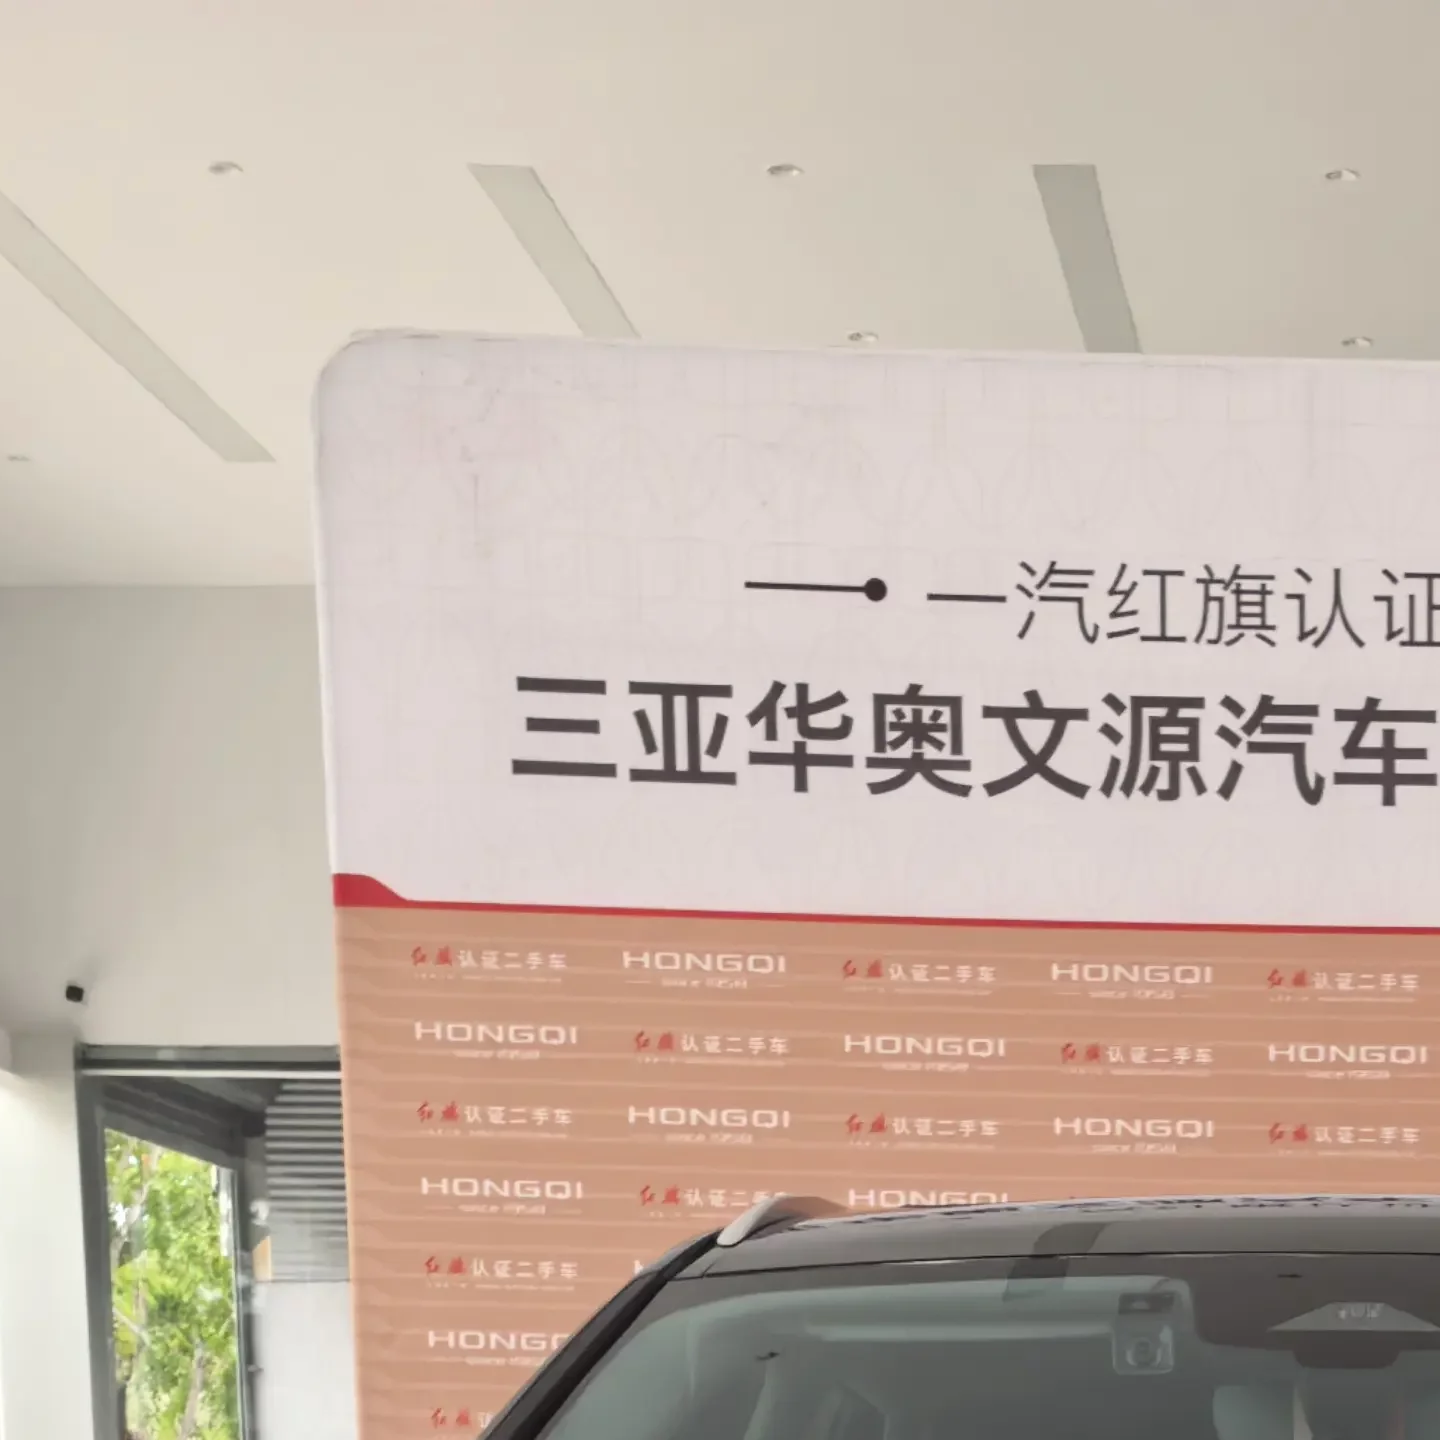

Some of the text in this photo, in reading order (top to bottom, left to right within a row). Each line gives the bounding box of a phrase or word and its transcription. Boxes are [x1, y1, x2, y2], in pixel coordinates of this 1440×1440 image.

[622, 950, 786, 973] HONGQI
[1051, 962, 1213, 984] HONGQI
[414, 1021, 578, 1045] HONGQI
[844, 1034, 1006, 1058] HONGQI
[1268, 1044, 1428, 1065] HONGQI
[627, 1105, 790, 1129] HONGQI
[1053, 1116, 1214, 1139] HONGQI
[420, 1176, 583, 1200] HONGQI
[427, 1330, 570, 1352] HONG
